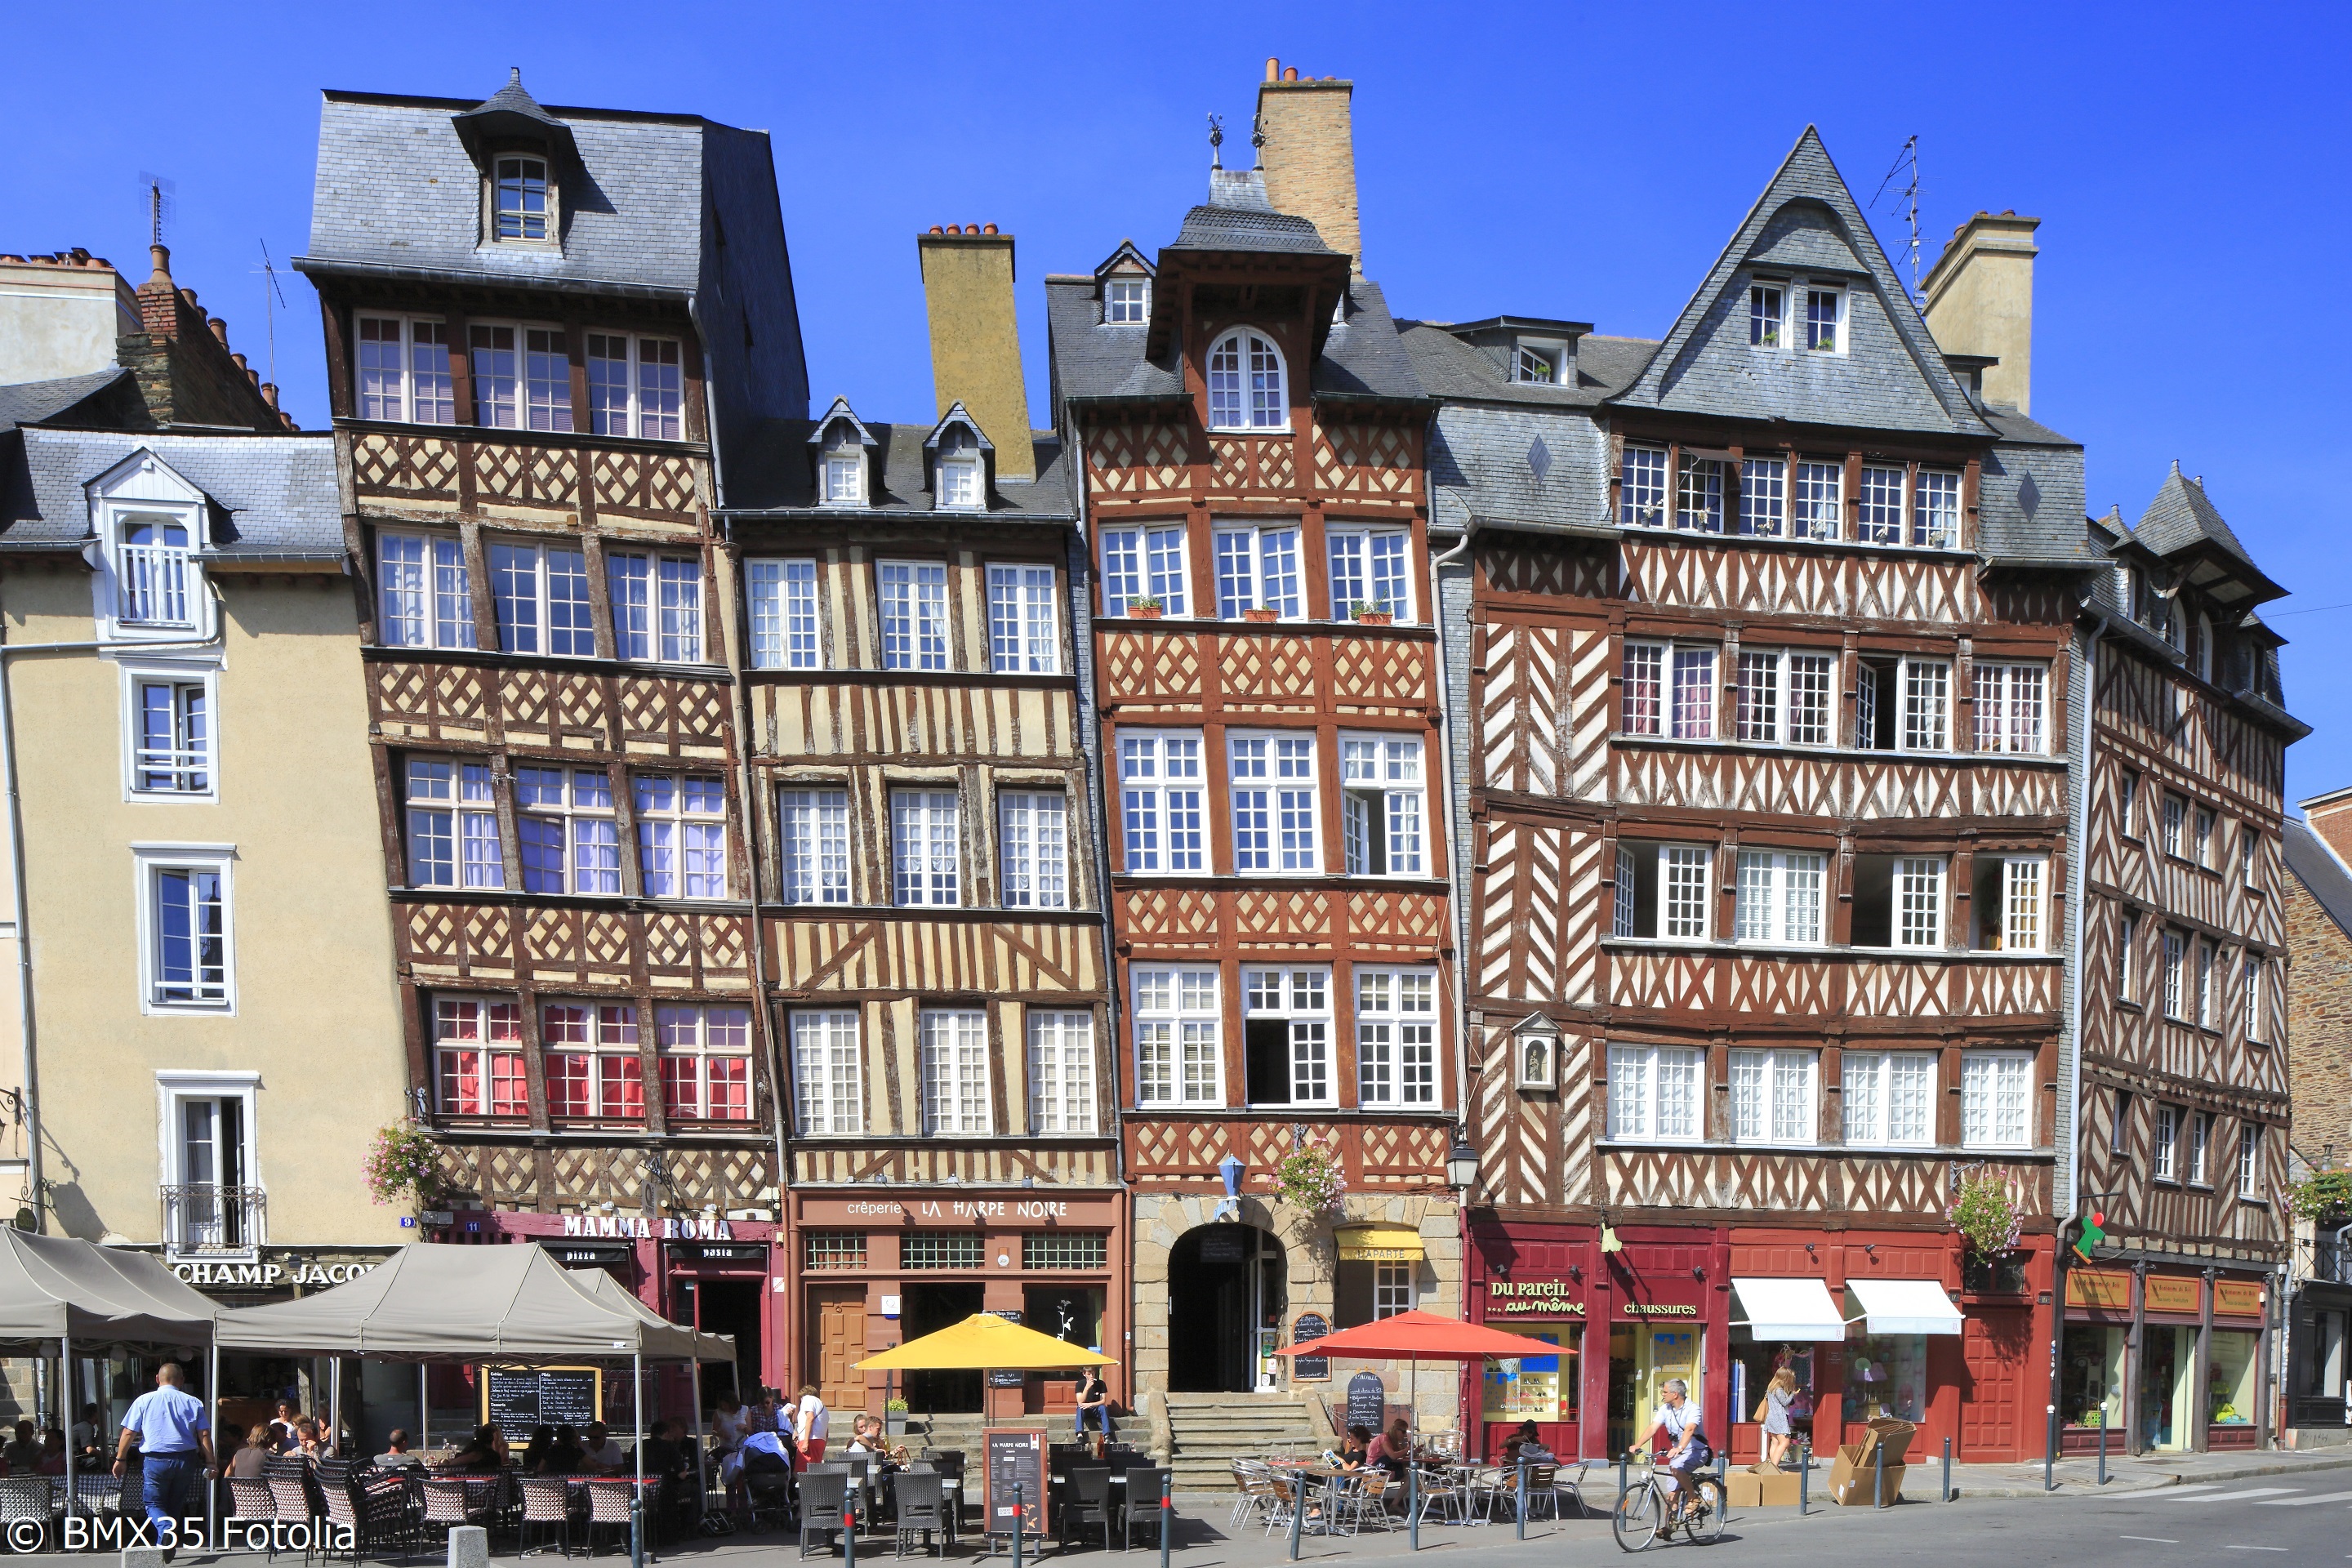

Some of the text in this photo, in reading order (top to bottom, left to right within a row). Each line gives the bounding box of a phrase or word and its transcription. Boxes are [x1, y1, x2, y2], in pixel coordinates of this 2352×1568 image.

[847, 1200, 1067, 1218] crêperie LA HARPE NOIRE
[404, 1218, 412, 1227] 9
[469, 1223, 478, 1231] 11
[564, 1215, 732, 1241] MAMMA ROMA
[566, 1251, 595, 1262] pizza
[703, 1247, 733, 1258] pasta
[1357, 1248, 1405, 1258] L'APARTÉ
[172, 1263, 282, 1285] CHAMP
[1505, 1300, 1533, 1312] au
[1532, 1298, 1586, 1315] même
[1624, 1302, 1697, 1315] chaussures
